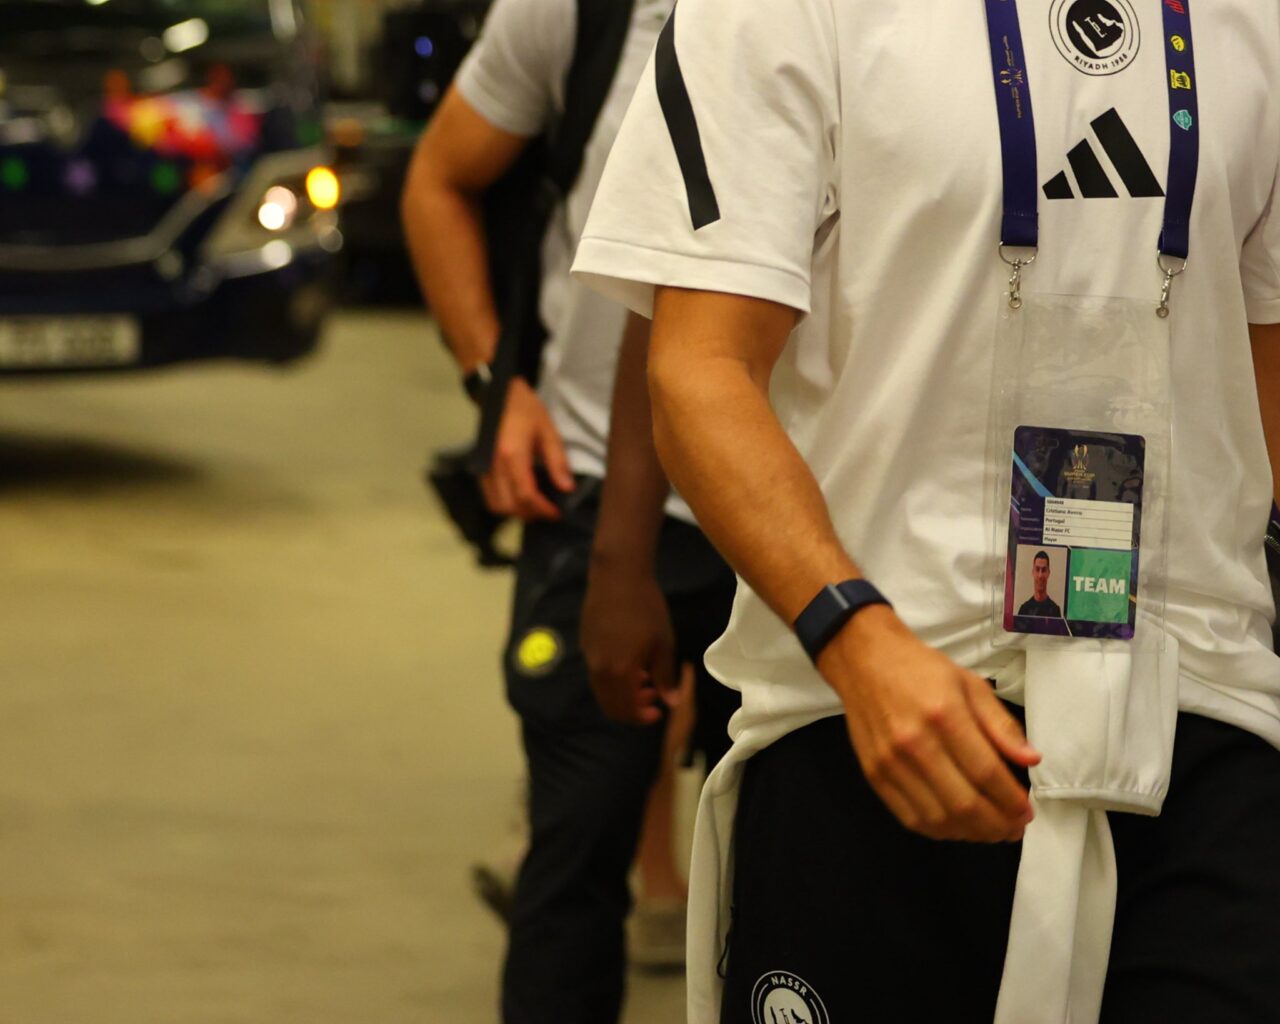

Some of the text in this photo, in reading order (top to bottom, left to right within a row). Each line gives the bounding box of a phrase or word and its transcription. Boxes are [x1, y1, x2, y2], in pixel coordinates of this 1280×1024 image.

[1074, 55, 1108, 70] RIYADH
[1073, 576, 1126, 595] TEAM
[771, 976, 807, 996] NASSR
